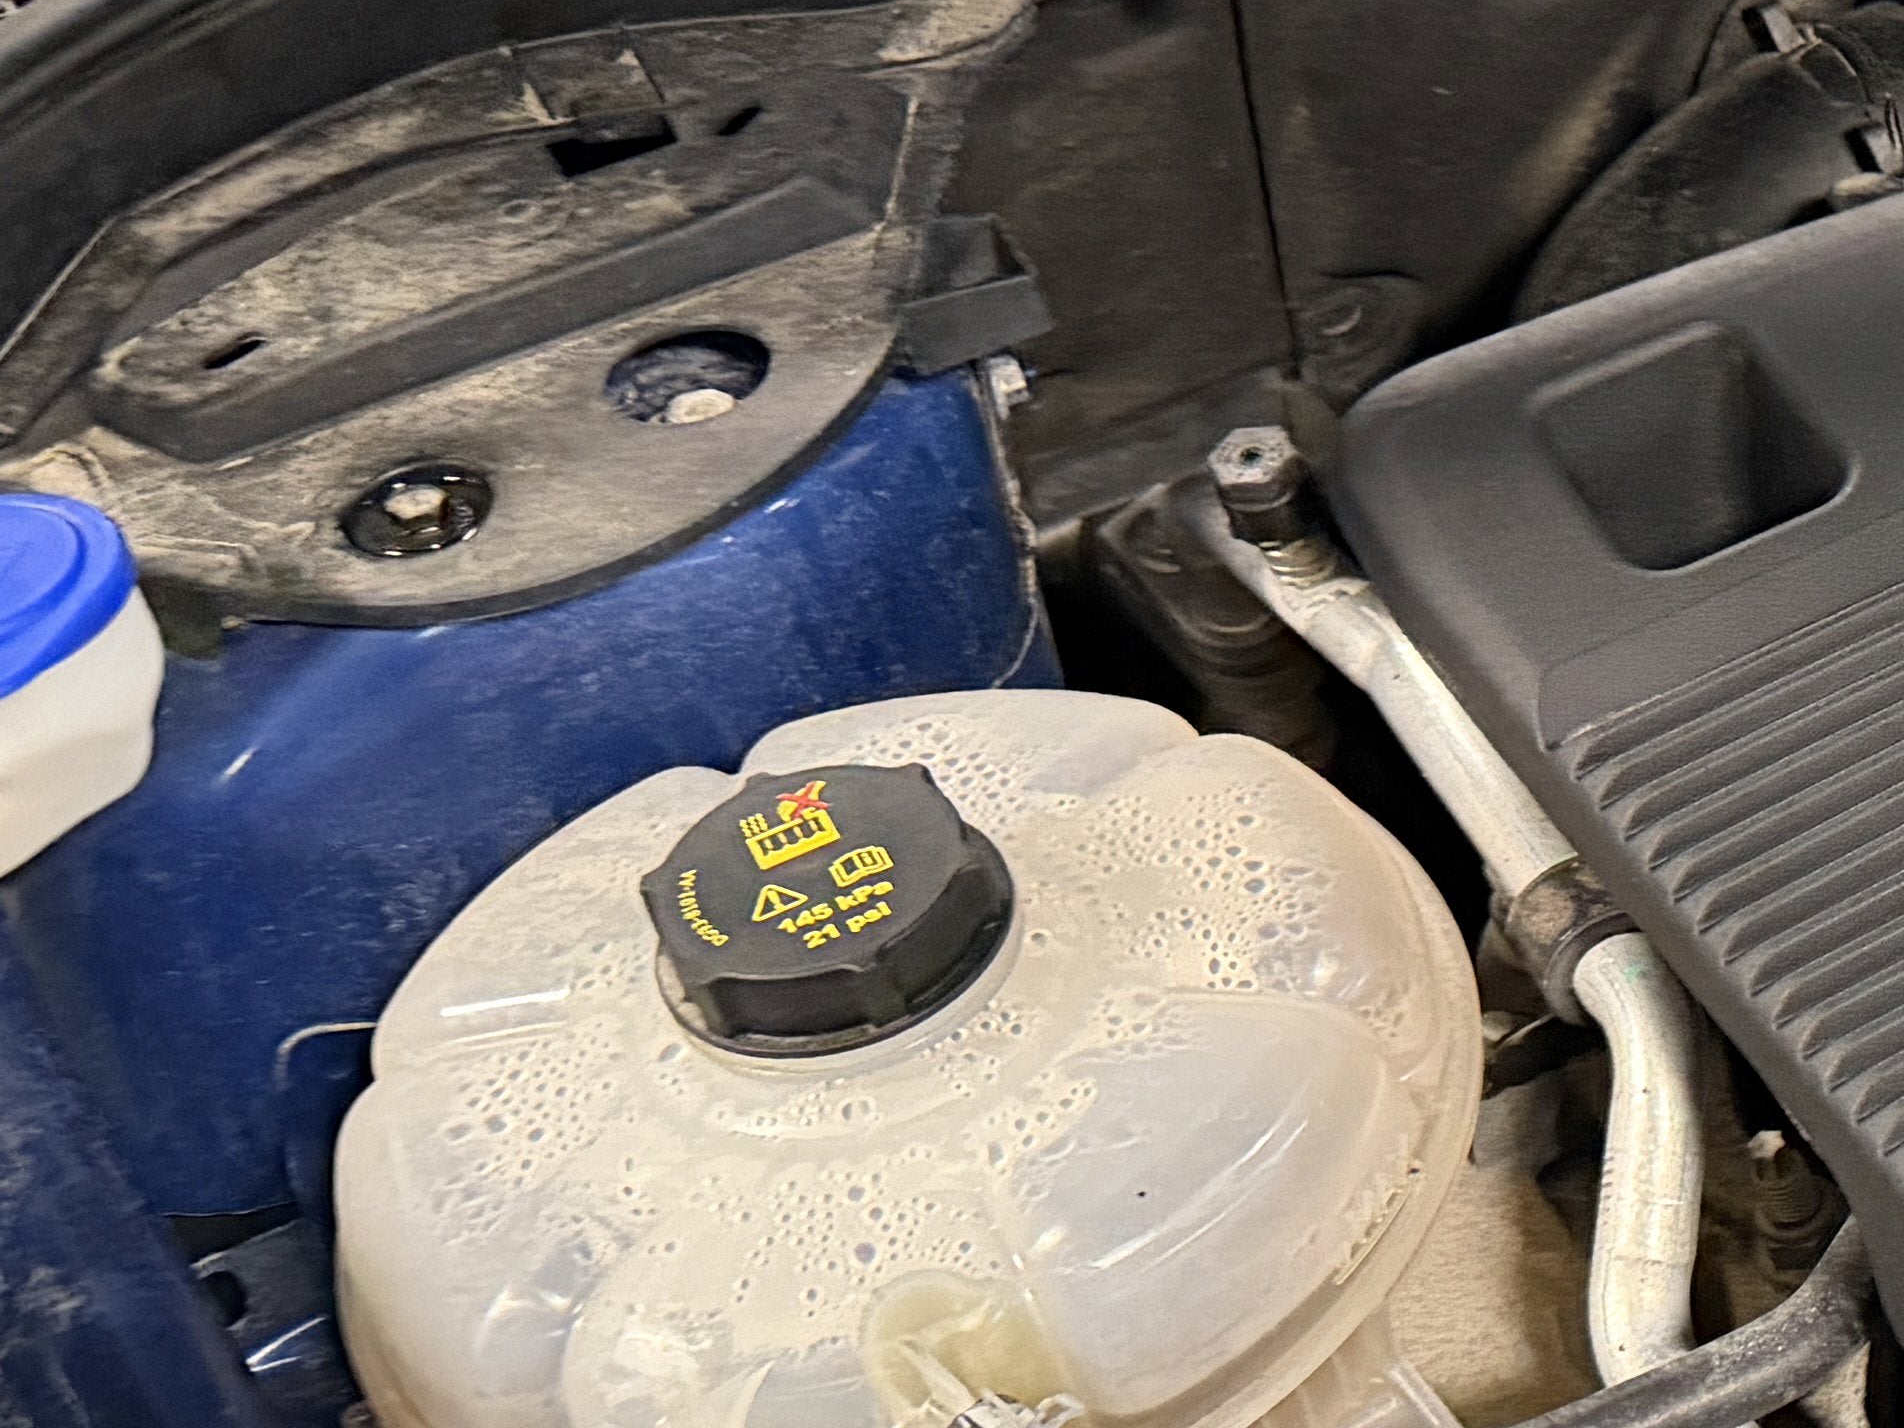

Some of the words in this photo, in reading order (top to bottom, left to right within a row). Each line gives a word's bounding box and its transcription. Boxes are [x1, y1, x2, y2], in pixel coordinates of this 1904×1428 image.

[777, 903, 834, 933] 145
[834, 881, 894, 911] kPa
[802, 924, 841, 949] 21
[845, 901, 892, 932] psi
